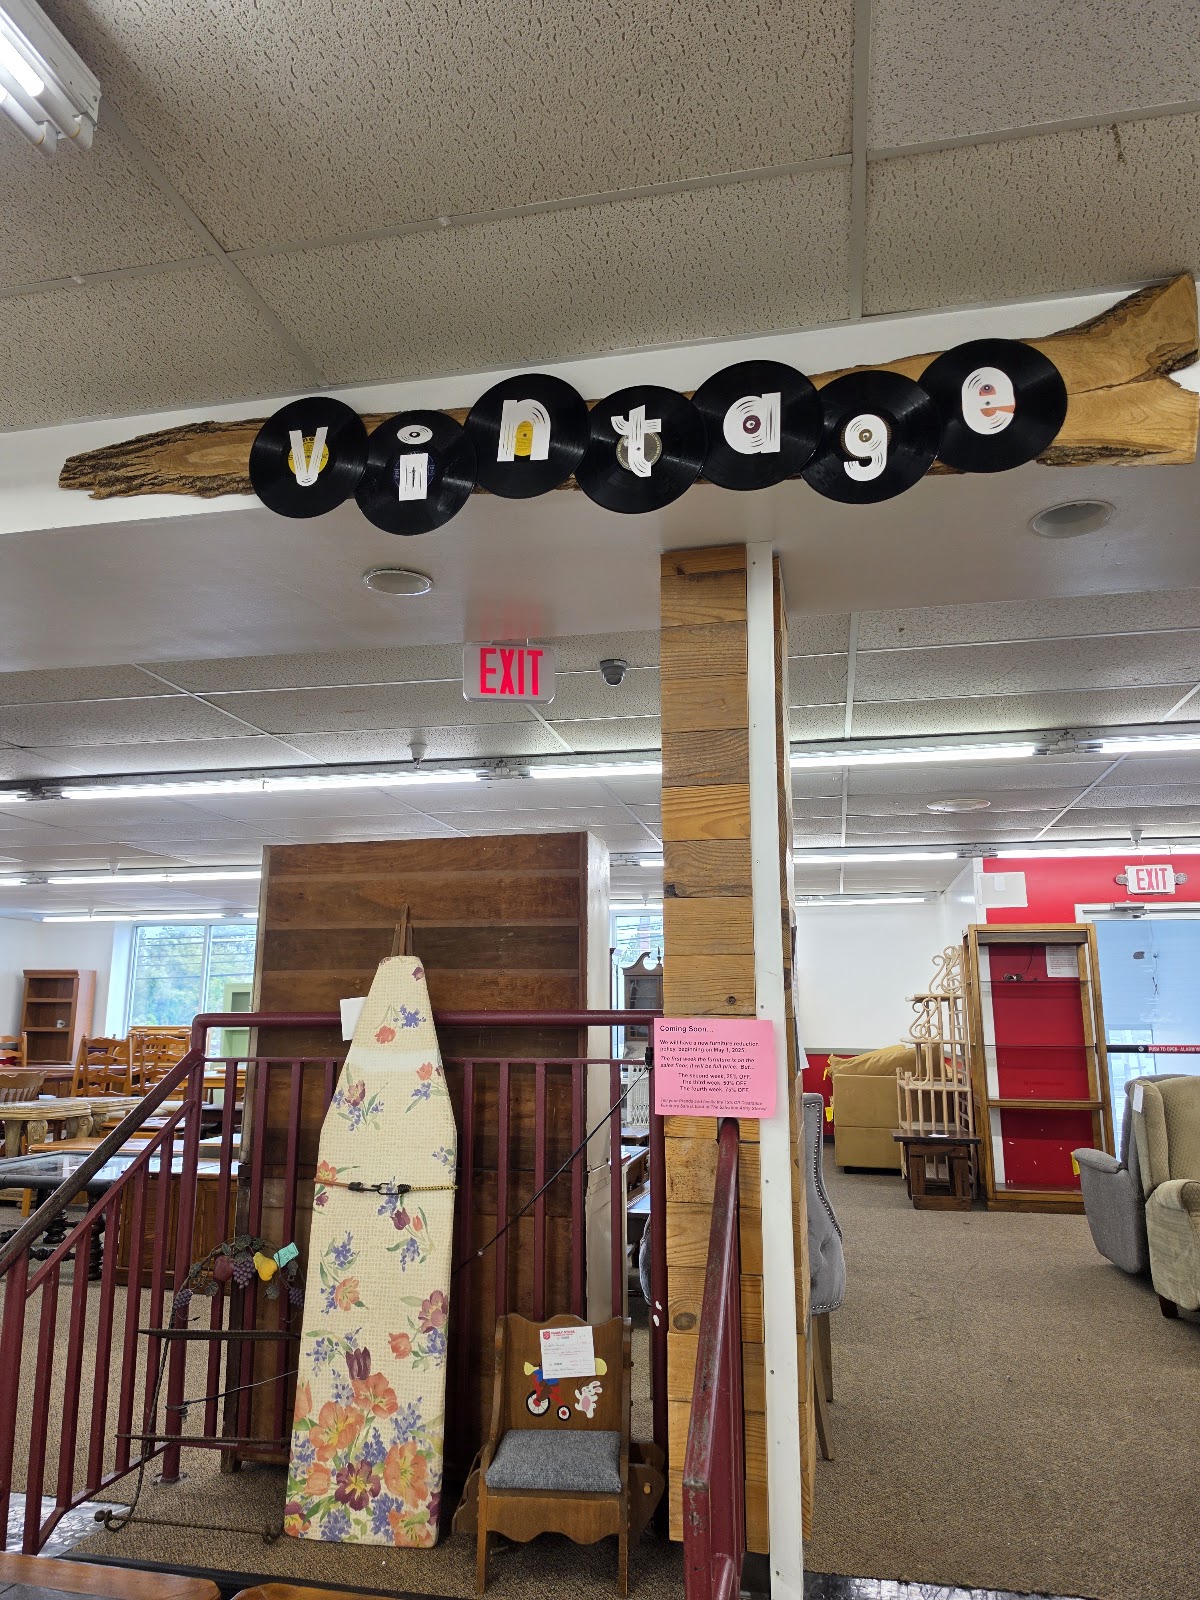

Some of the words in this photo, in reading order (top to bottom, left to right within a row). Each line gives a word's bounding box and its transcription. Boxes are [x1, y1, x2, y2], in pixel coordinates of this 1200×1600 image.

[287, 365, 1017, 502] vintage
[480, 648, 543, 695] EXIT
[1136, 868, 1167, 890] EXIT
